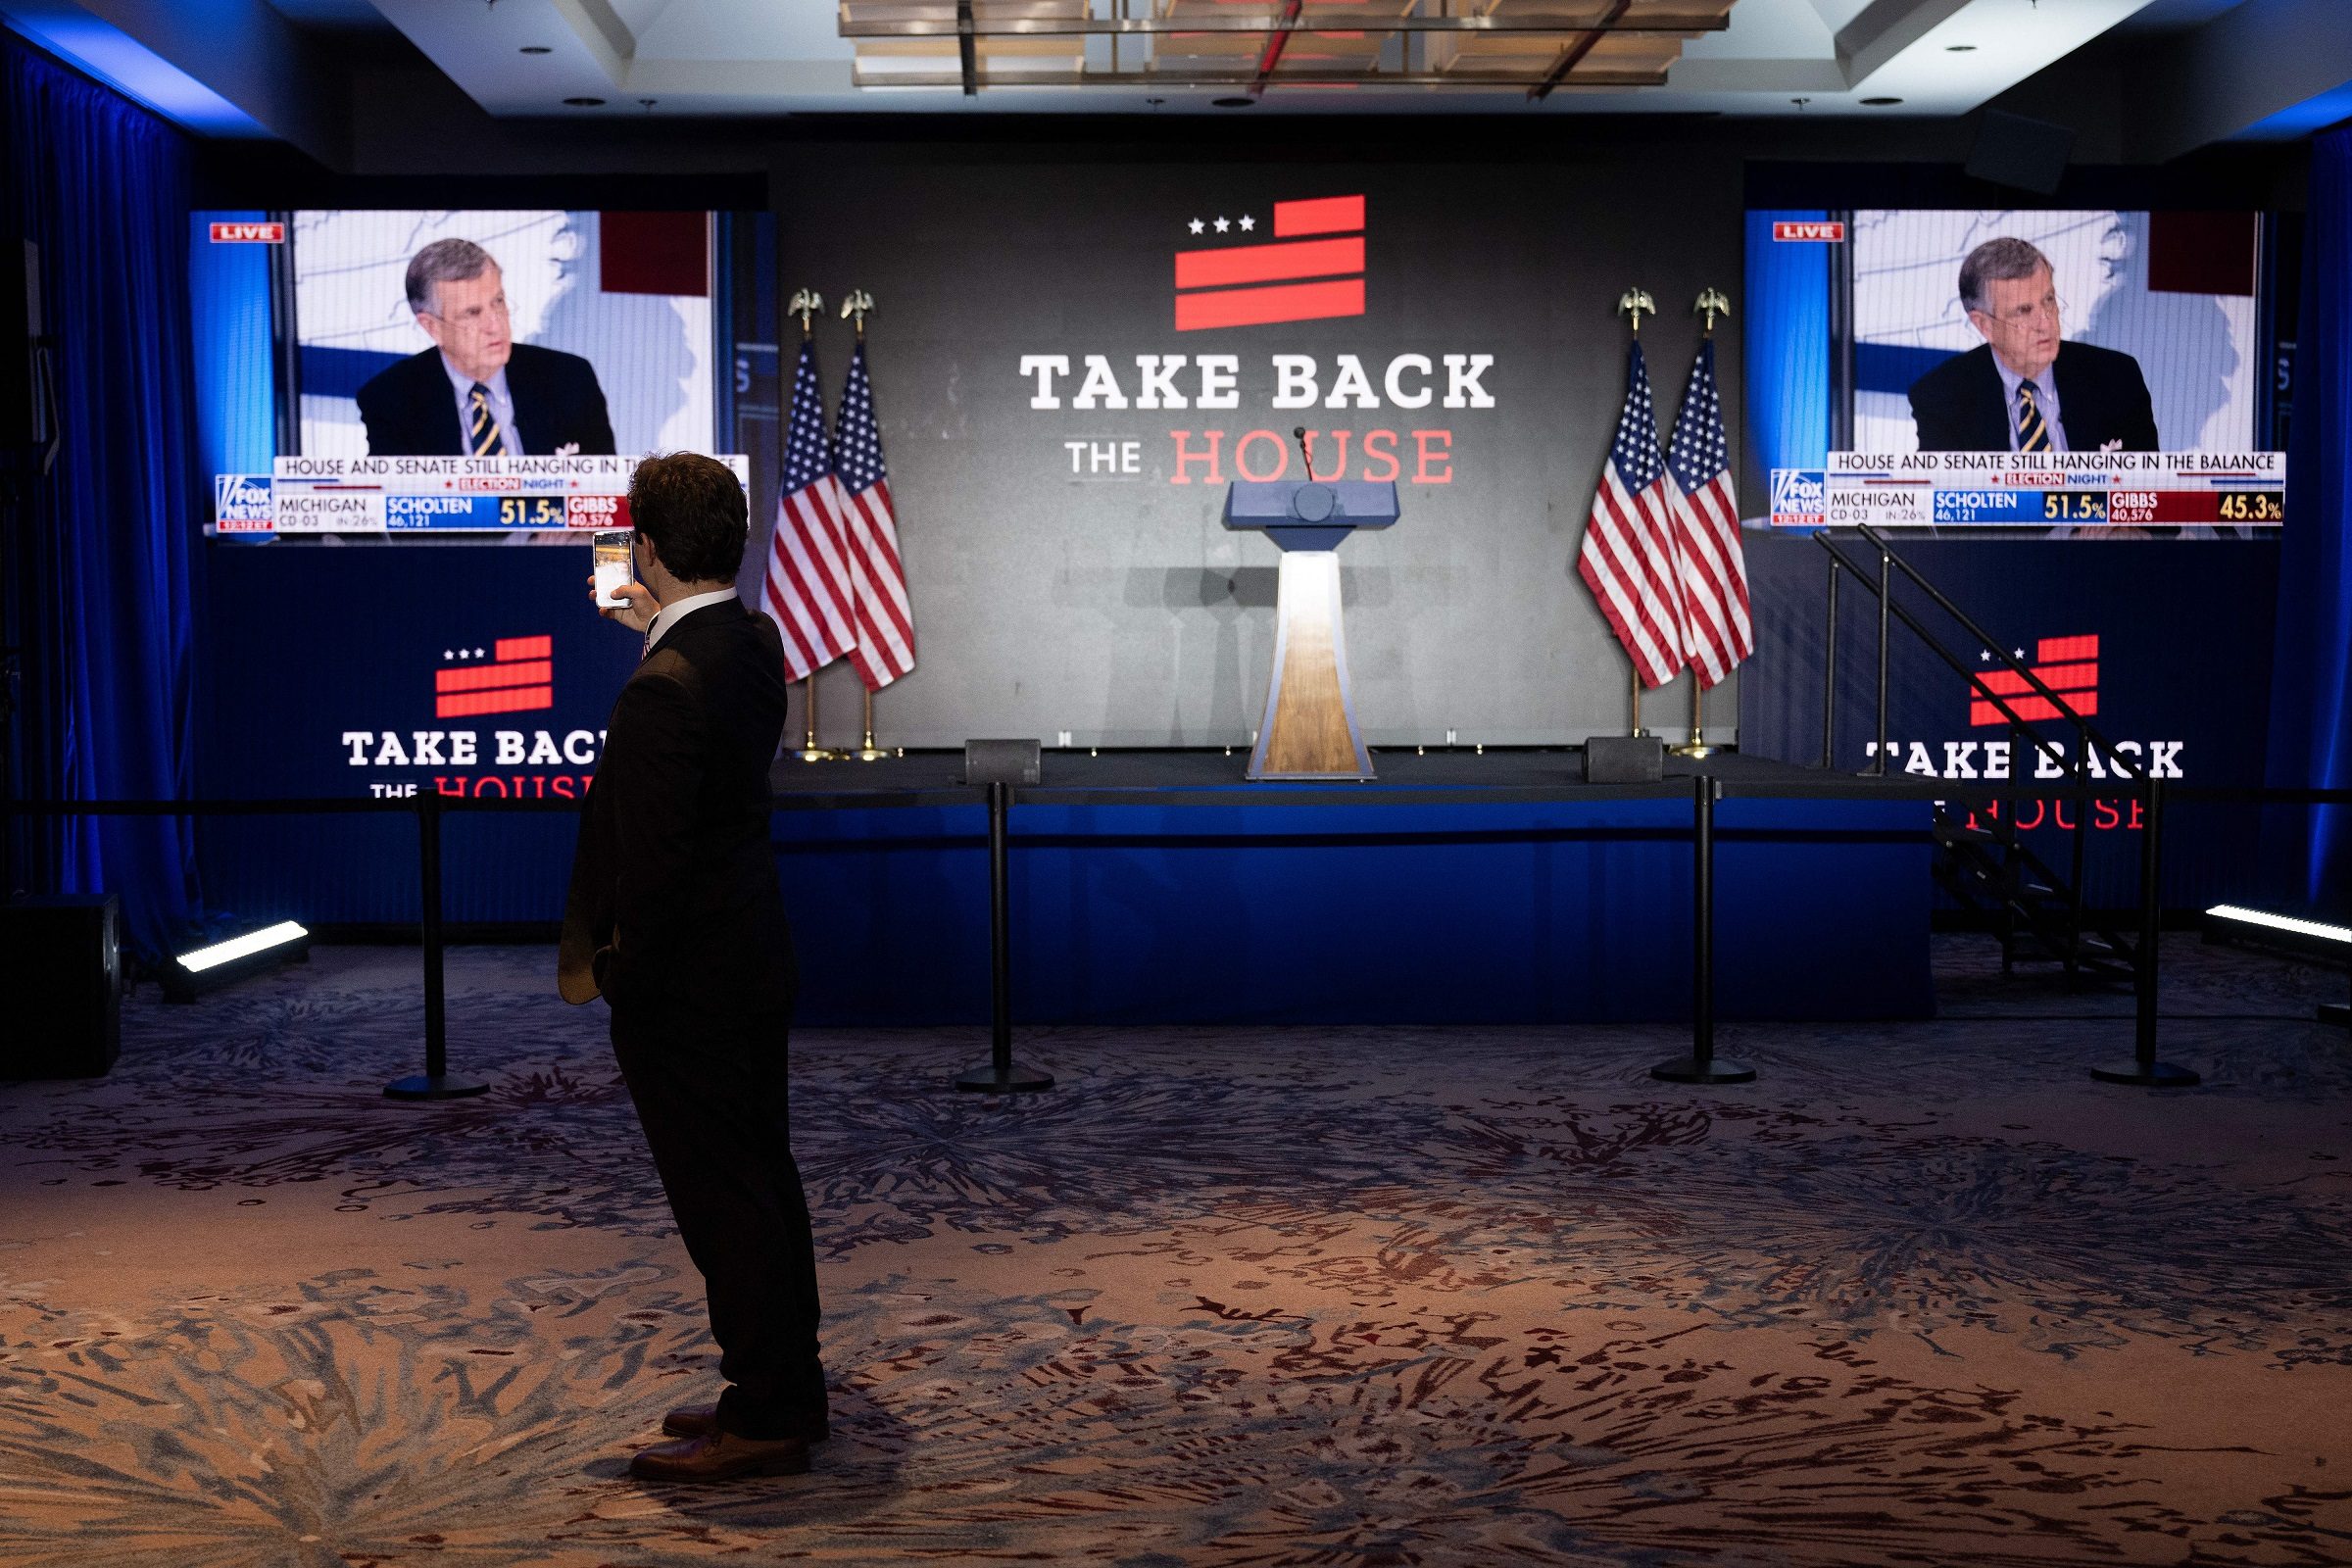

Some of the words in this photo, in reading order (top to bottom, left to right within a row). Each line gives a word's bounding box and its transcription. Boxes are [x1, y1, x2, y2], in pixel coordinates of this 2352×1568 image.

[220, 226, 274, 240] LIVE
[1784, 224, 1835, 238] LIVE
[1019, 355, 1240, 409] TAKE
[1272, 354, 1495, 409] BACK
[1064, 441, 1141, 472] THE
[1169, 429, 1453, 484] HOUSE
[1838, 455, 1894, 469] HOUSE
[1901, 455, 1938, 469] AND
[1944, 455, 2005, 470] SENATE
[2011, 455, 2047, 470] STILL
[2053, 455, 2136, 470] HANGING
[2142, 455, 2160, 470] IN
[2166, 455, 2194, 470] THE
[2200, 455, 2275, 470] BALANCE
[285, 459, 343, 474] HOUSE
[351, 459, 389, 474] AND
[396, 460, 458, 474] SENATE
[465, 460, 502, 474] STILL
[509, 459, 593, 474] HANGING
[600, 459, 617, 473] IN
[461, 478, 519, 489] ELECTION
[523, 479, 564, 489] NIGHT
[2007, 473, 2063, 485] ELECTION
[2067, 474, 2108, 485] NIGHT
[236, 488, 271, 505] FOX
[1790, 482, 1824, 498] FOX
[279, 499, 367, 513] MICHIGAN
[388, 498, 472, 514] SCHOLTEN
[569, 497, 617, 513] GIBBS
[1781, 498, 1825, 514] NEWS
[1832, 493, 1915, 507] MICHIGAN
[1936, 492, 2017, 508] SCHOLTEN
[2044, 494, 2106, 518] 51.5%
[2112, 493, 2157, 508] GIBBS
[2220, 494, 2281, 519] 45.3%
[226, 505, 272, 519] NEWS
[500, 499, 564, 524] 51.5%
[1936, 509, 1976, 521] 46,121
[2112, 508, 2153, 521] 40,576
[388, 514, 430, 527] 46,121
[570, 514, 613, 526] 40,576
[342, 731, 477, 765] TAKE
[495, 730, 608, 765] BAC
[2034, 741, 2183, 779] BACK
[369, 784, 417, 799] THE
[434, 776, 593, 798] HOUS
